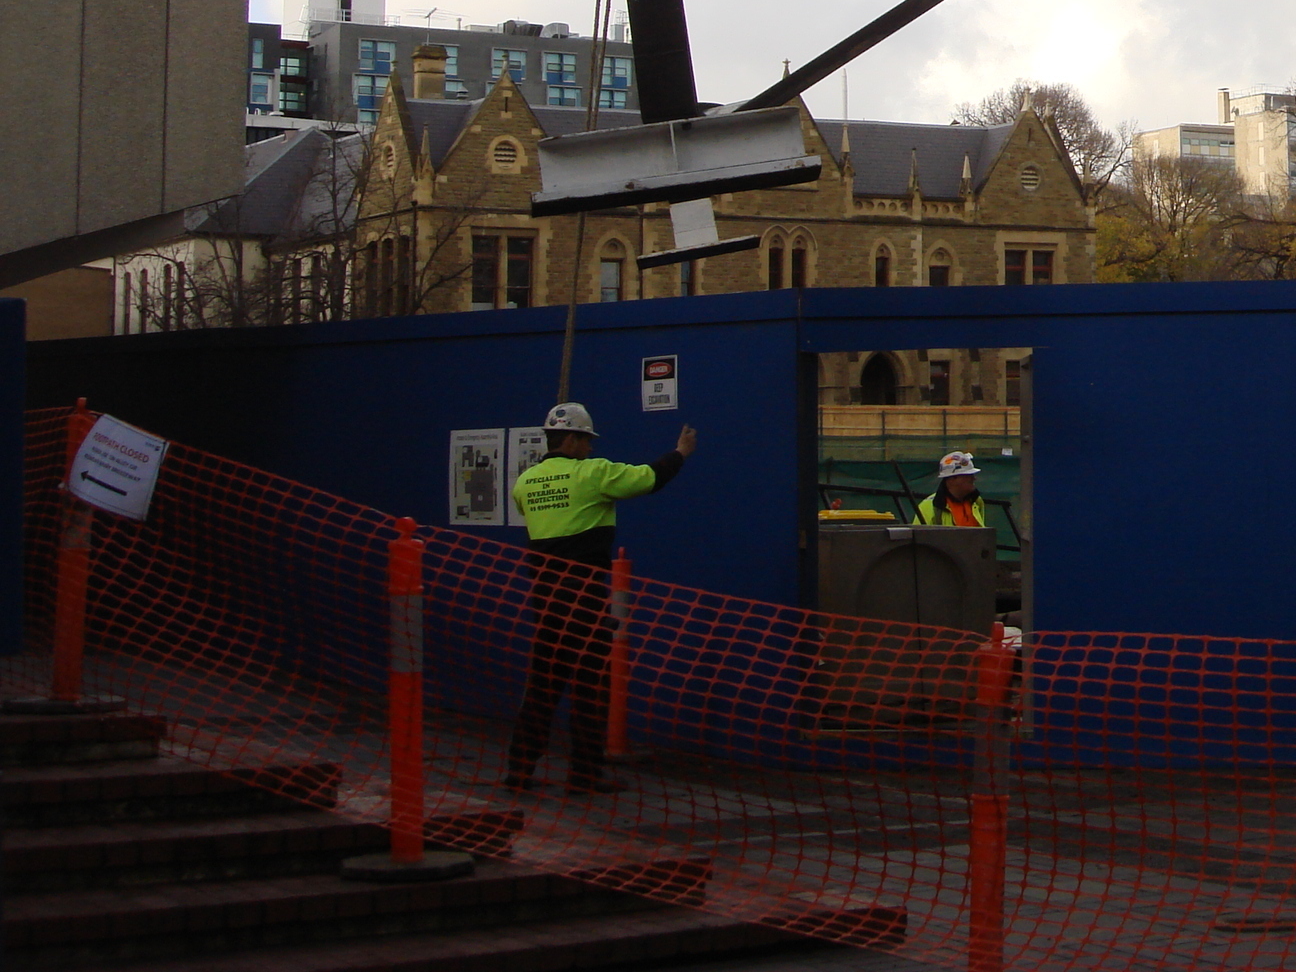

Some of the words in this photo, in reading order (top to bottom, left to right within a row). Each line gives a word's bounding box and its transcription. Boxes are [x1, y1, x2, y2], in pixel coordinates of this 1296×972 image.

[119, 445, 149, 463] CLOSED
[525, 474, 570, 484] SPECIALISTS
[527, 488, 568, 498] OVERHEAD
[527, 494, 569, 505] PROTECTION
